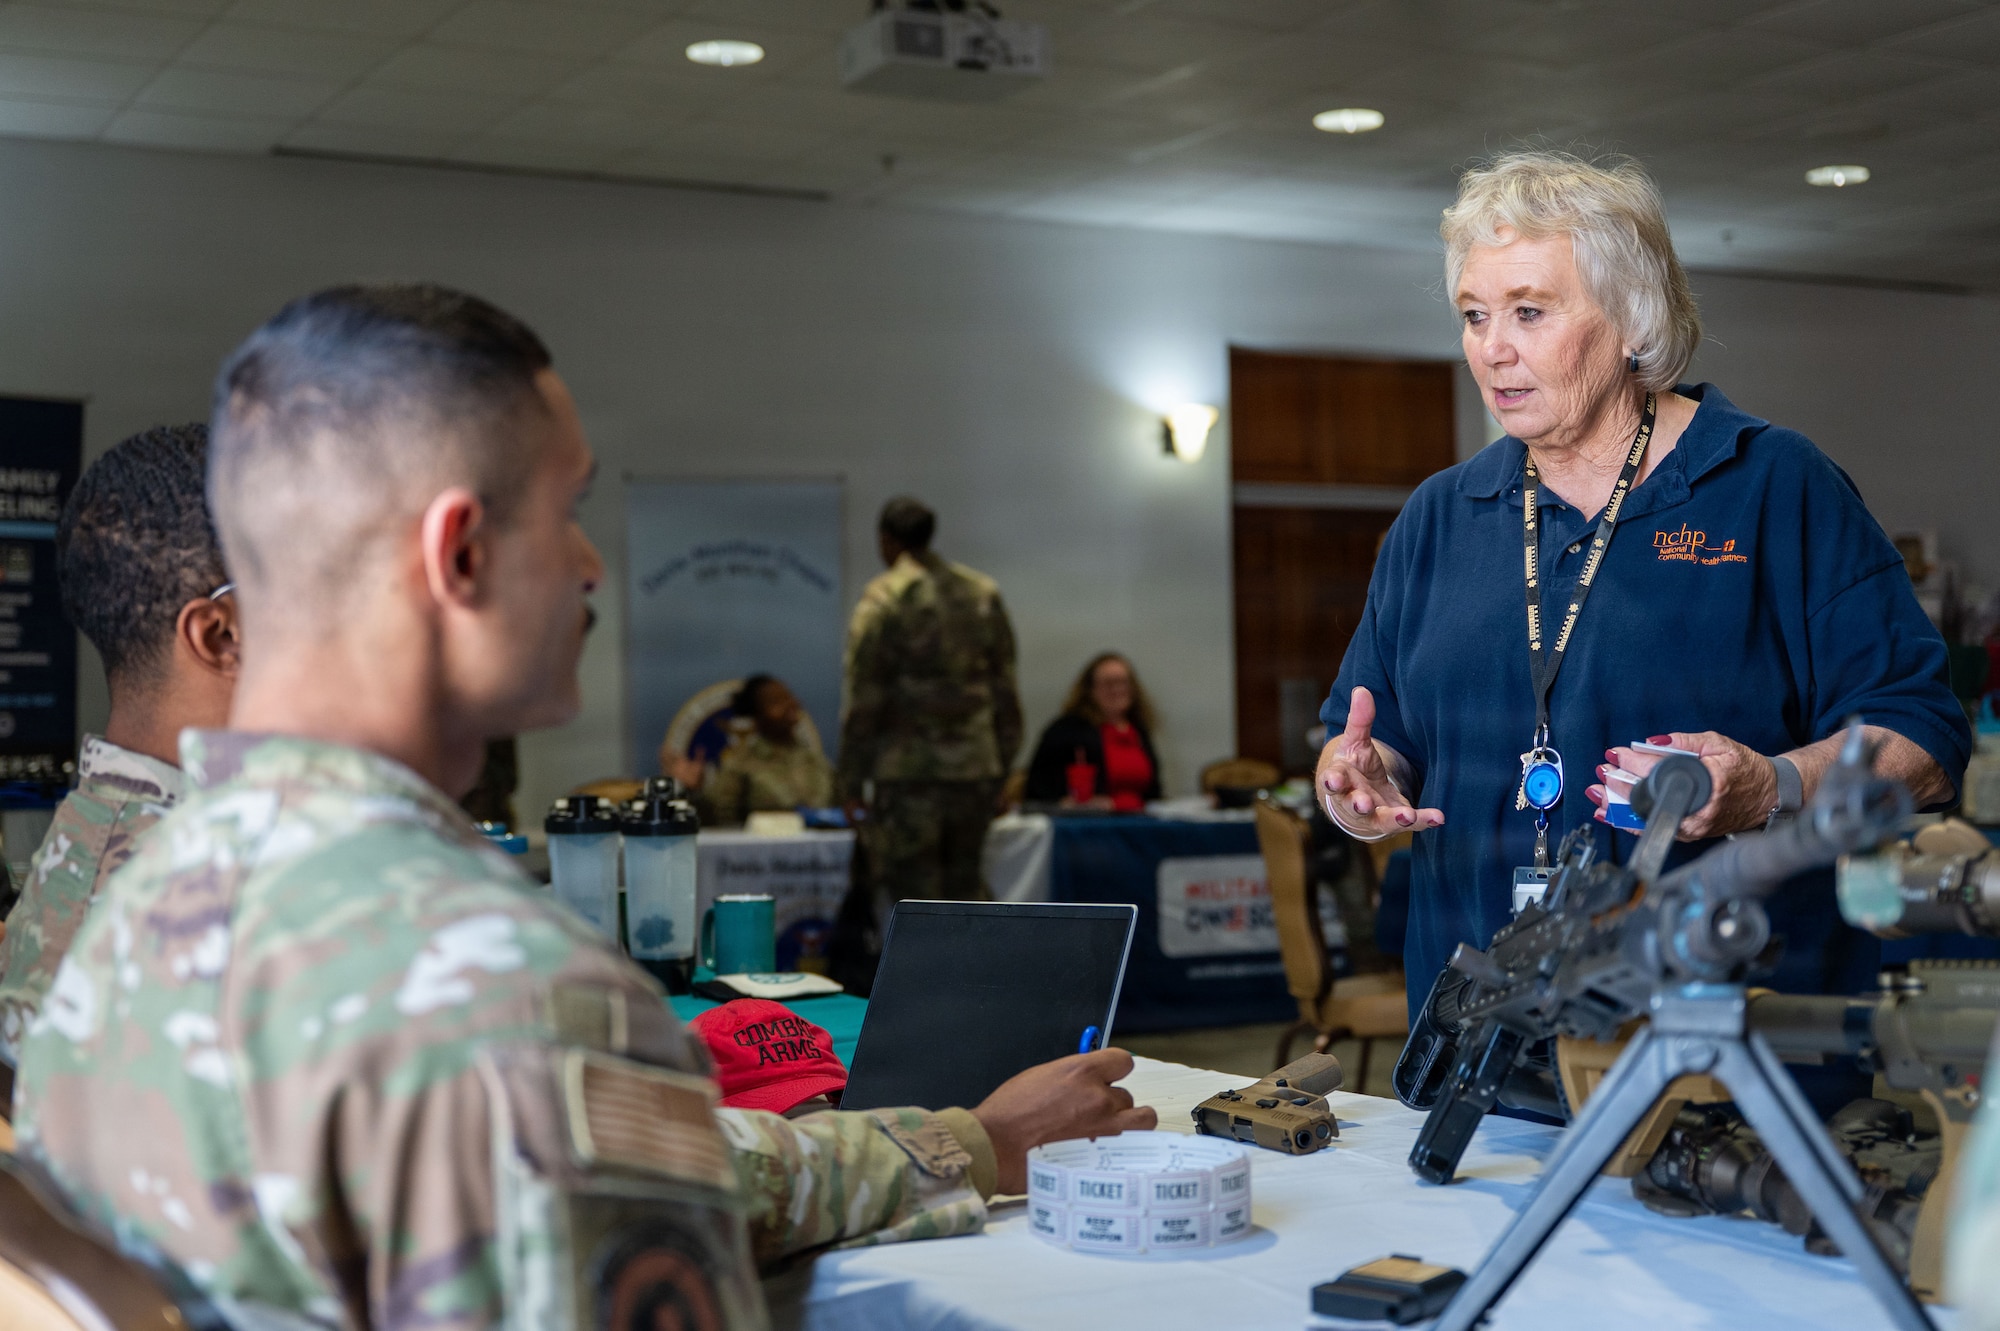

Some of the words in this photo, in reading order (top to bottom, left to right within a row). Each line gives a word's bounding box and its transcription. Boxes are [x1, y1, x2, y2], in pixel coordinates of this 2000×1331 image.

[1653, 522, 1706, 552] nchp
[1659, 546, 1688, 555] National
[733, 1017, 816, 1047] COMBAT
[759, 1039, 822, 1066] ARMS
[1079, 1179, 1123, 1200] TICKET
[1154, 1182, 1198, 1201] TICKET
